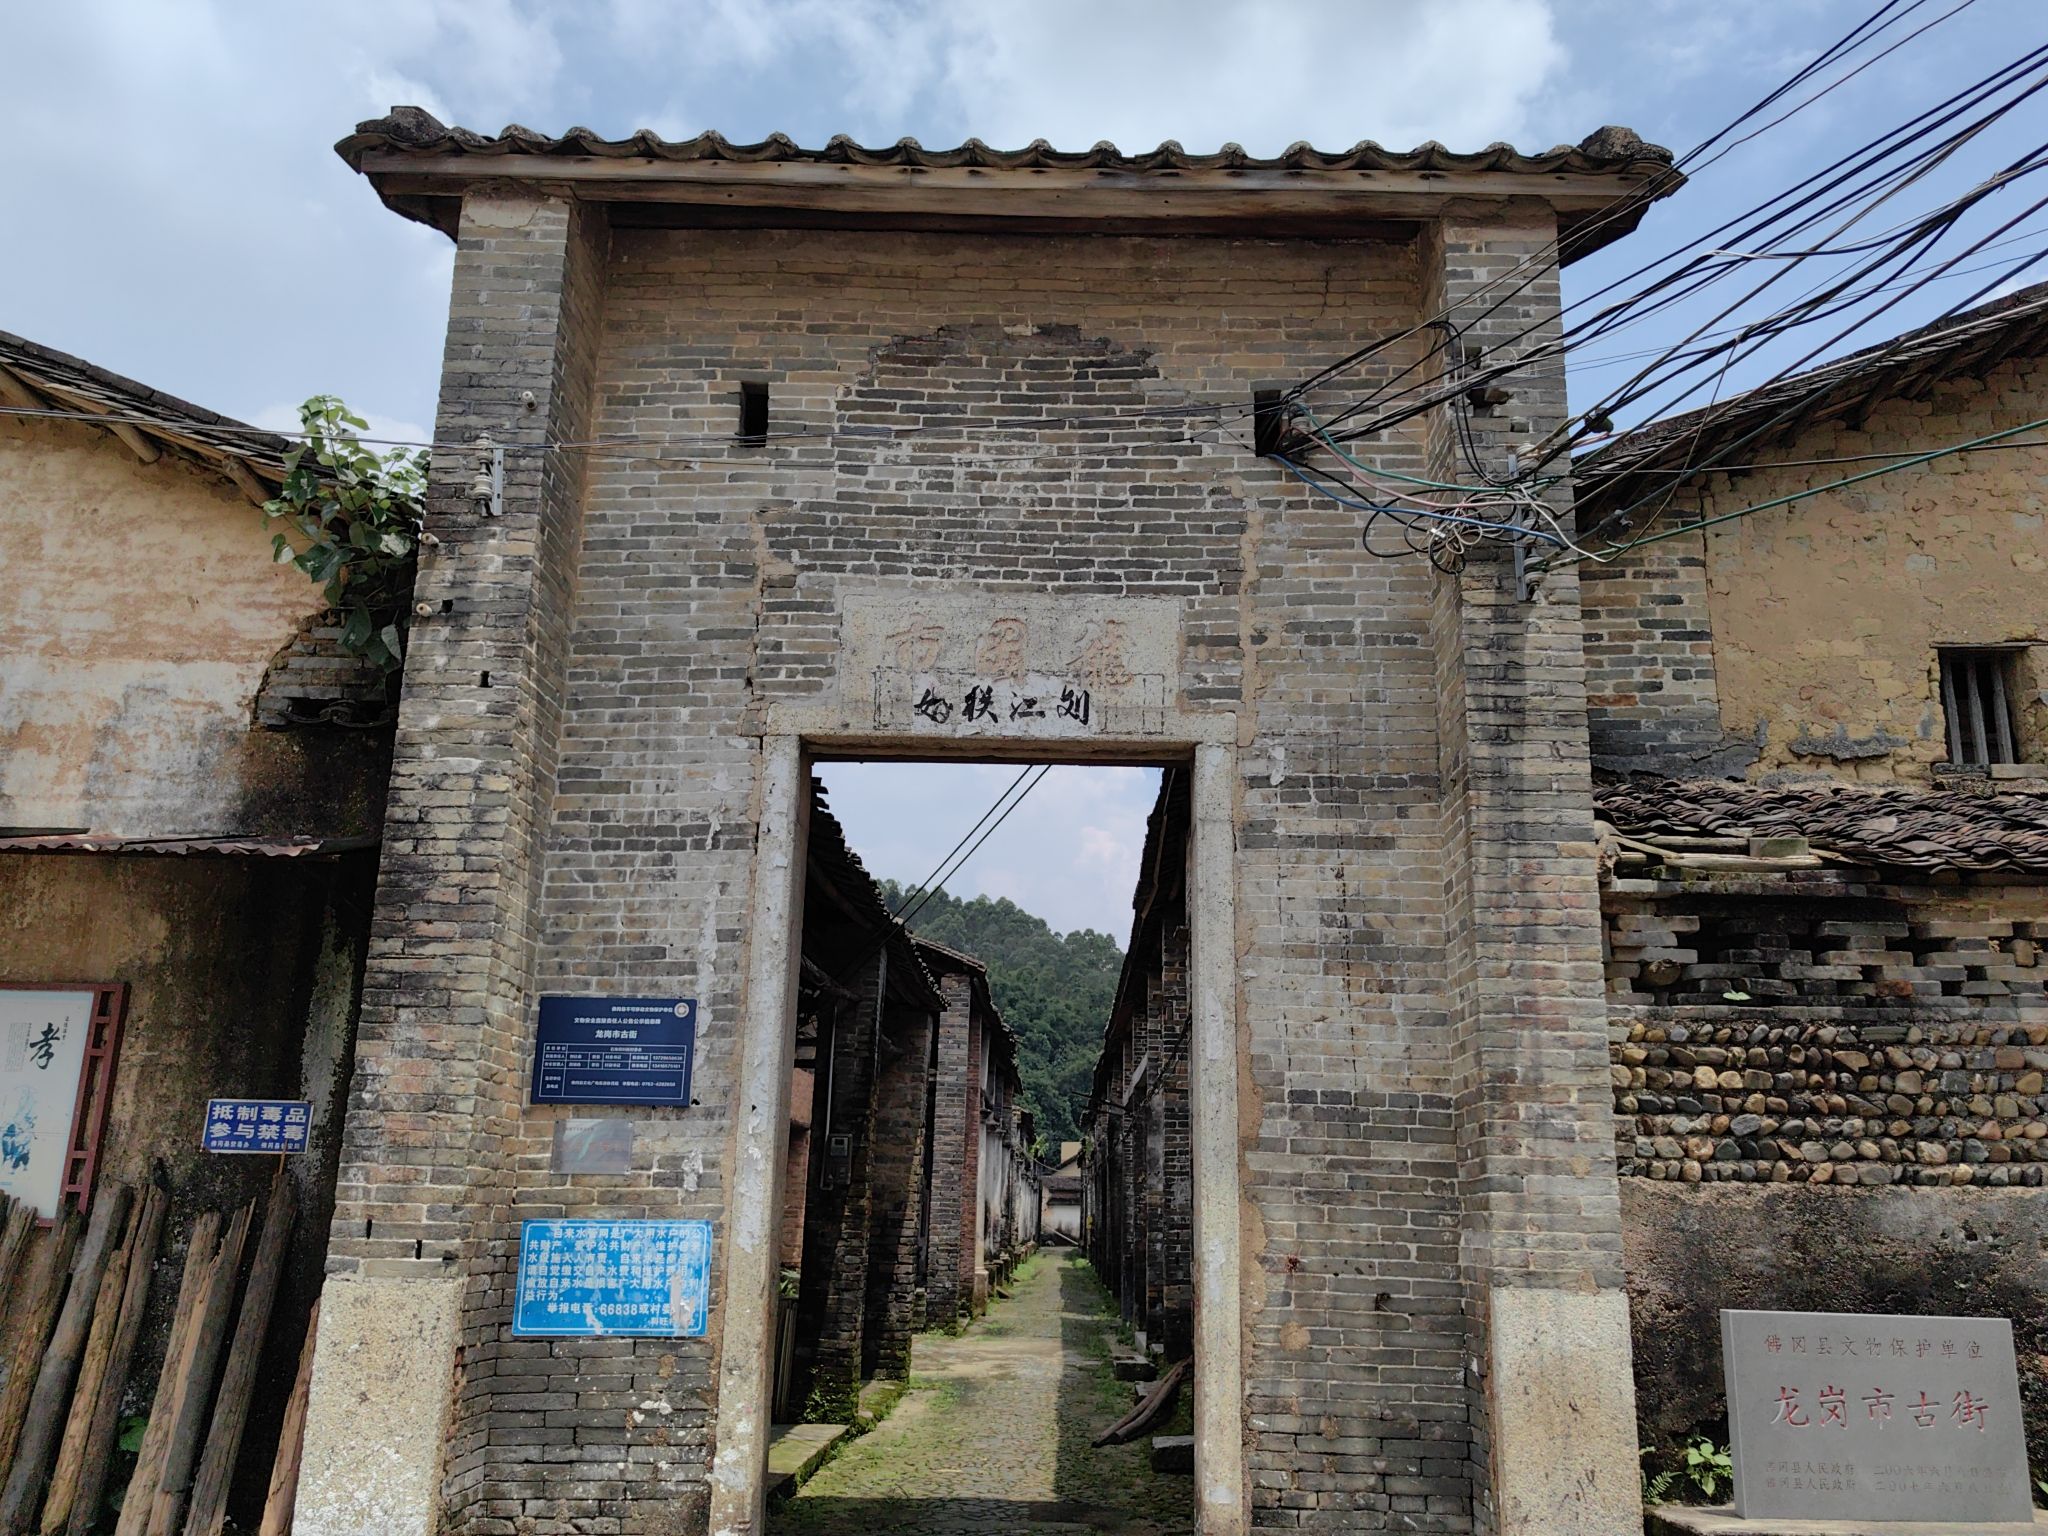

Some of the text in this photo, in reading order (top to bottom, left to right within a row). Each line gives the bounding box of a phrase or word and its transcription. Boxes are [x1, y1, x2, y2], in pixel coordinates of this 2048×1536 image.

[595, 1029, 638, 1039] 龙岗市古街
[29, 1022, 61, 1070] 孝
[211, 1104, 307, 1124] 抵制毒品
[209, 1122, 305, 1141] 参与禁毒
[523, 1290, 564, 1301] 益行为。
[1763, 1335, 1985, 1361] 佛冈县文物保护单位
[1770, 1384, 1990, 1433] 龙岗市古街
